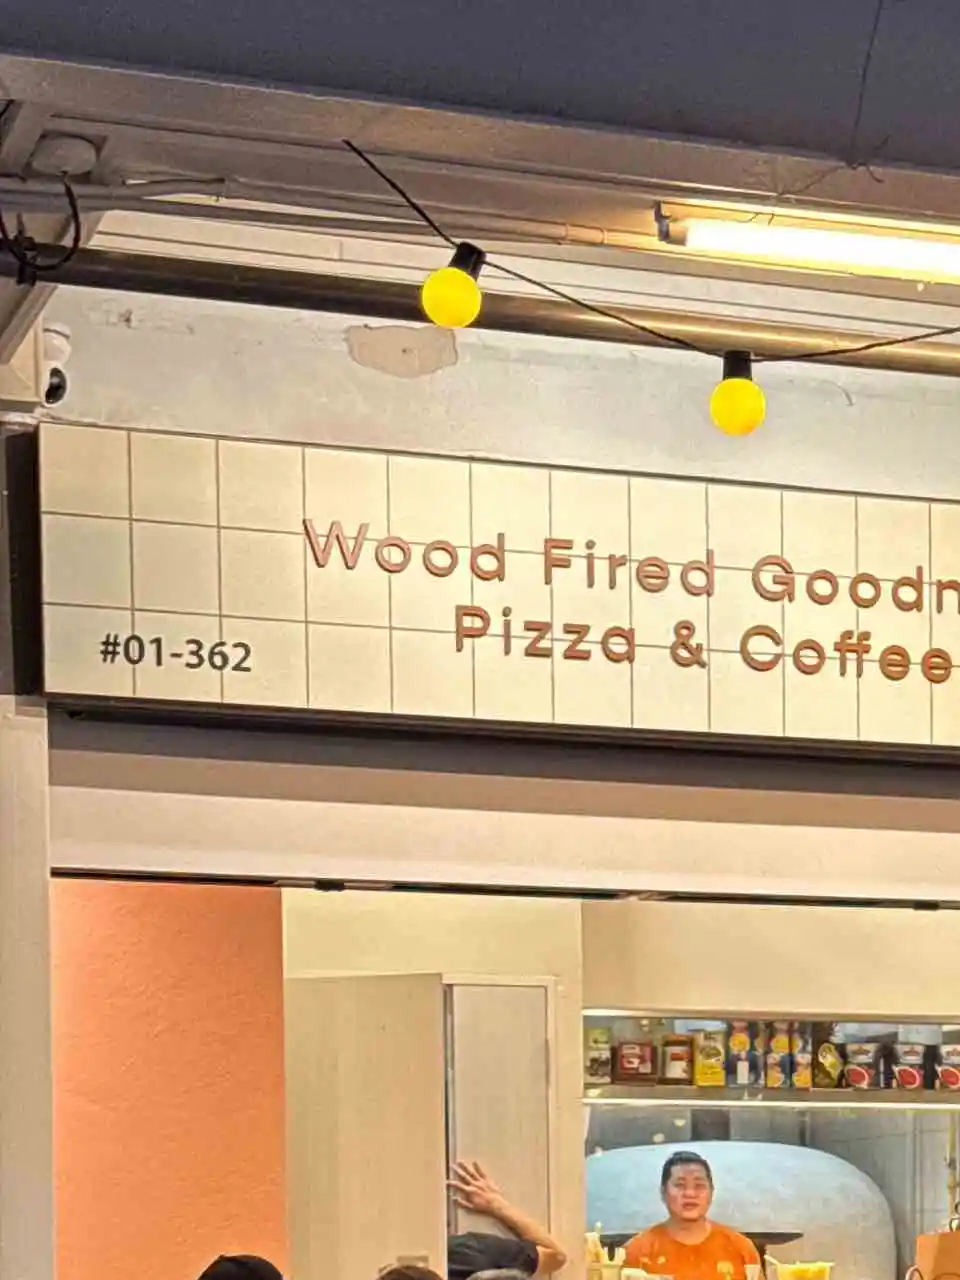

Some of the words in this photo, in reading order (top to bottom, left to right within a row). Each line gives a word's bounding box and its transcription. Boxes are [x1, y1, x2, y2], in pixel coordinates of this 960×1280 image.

[302, 519, 505, 582] Wood
[544, 538, 715, 597] Fired
[100, 633, 251, 672] #01-362
[455, 605, 636, 664] Pizza
[670, 620, 707, 668] &
[740, 625, 953, 684] Coffee
